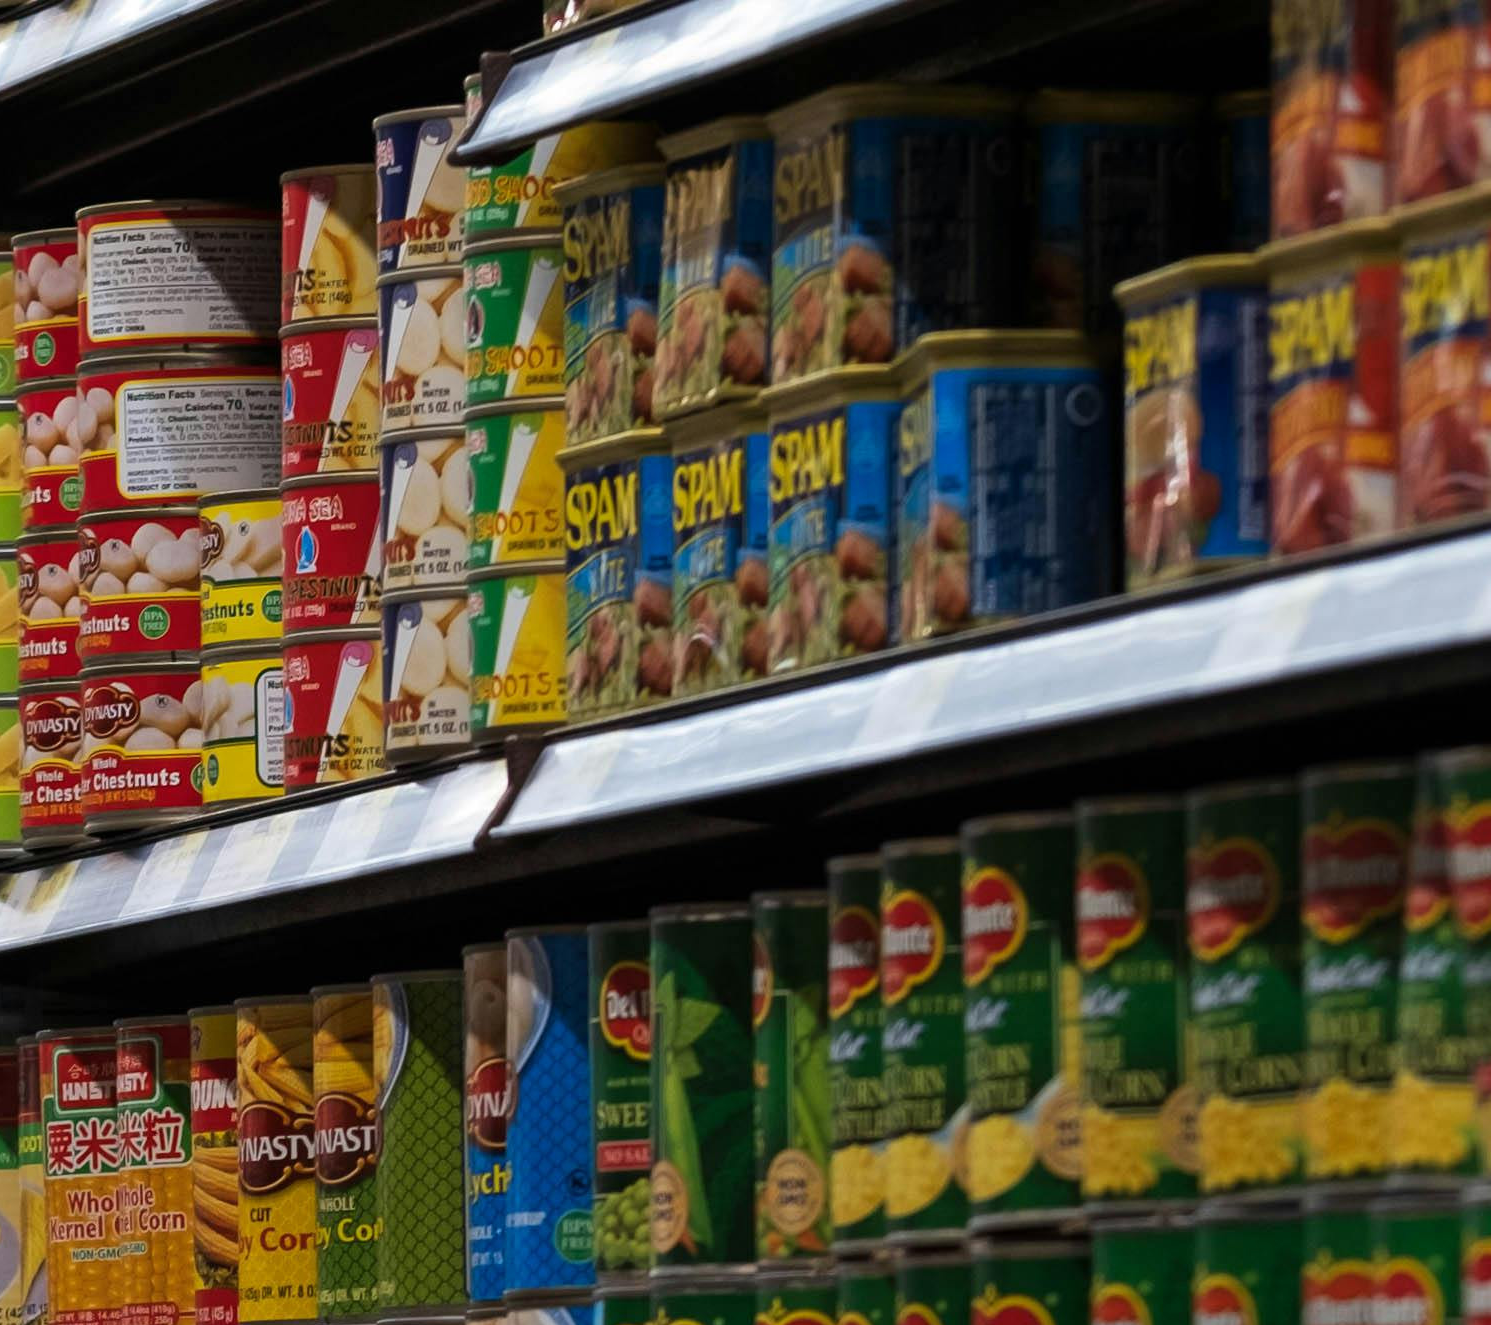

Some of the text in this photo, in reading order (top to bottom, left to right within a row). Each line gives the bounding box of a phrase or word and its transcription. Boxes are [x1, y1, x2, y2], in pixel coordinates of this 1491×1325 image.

[487, 346, 562, 376] SHOOT
[127, 390, 195, 402] Nutrition Facts
[423, 387, 450, 398] WATER
[185, 402, 224, 412] Calories
[770, 416, 845, 501] SPAM
[672, 445, 743, 530] SPAM
[566, 470, 638, 550] SPAM
[424, 548, 450, 557] WATER
[84, 702, 133, 722] DYNASTY
[428, 709, 457, 718] WATER
[26, 718, 81, 735] DYNASTY
[93, 758, 117, 770] Whole
[35, 771, 63, 783] Whole
[94, 769, 180, 790] Chestnuts
[37, 785, 82, 803] Chest
[596, 1102, 649, 1130] SWEE
[139, 1209, 186, 1232] Corn
[250, 1207, 271, 1222] CUT
[49, 1215, 104, 1242] Kernel
[260, 1227, 316, 1251] Cor
